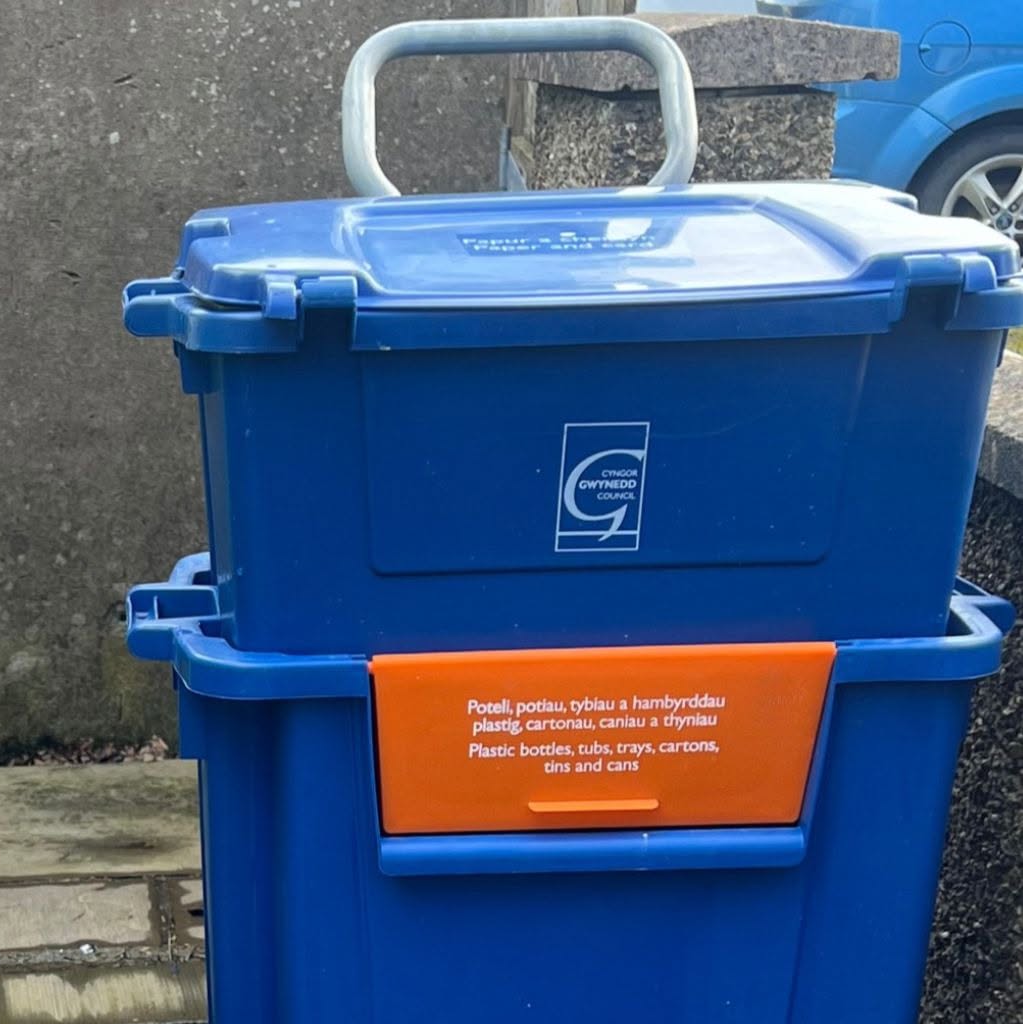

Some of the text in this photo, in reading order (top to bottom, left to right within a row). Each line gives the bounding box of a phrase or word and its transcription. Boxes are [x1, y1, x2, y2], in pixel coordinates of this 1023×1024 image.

[601, 469, 638, 478] CYNGOR
[578, 479, 637, 490] GWYNEDD
[596, 491, 636, 500] COUNCIL
[467, 693, 726, 717] Poteli, potiau, tybiau a hambyrddau
[472, 712, 717, 736] plastig, cartonau, caniau a thyniau
[468, 739, 720, 758] Plastic bottles, tubs, trays, cartons,
[543, 758, 639, 774] tins and cans
